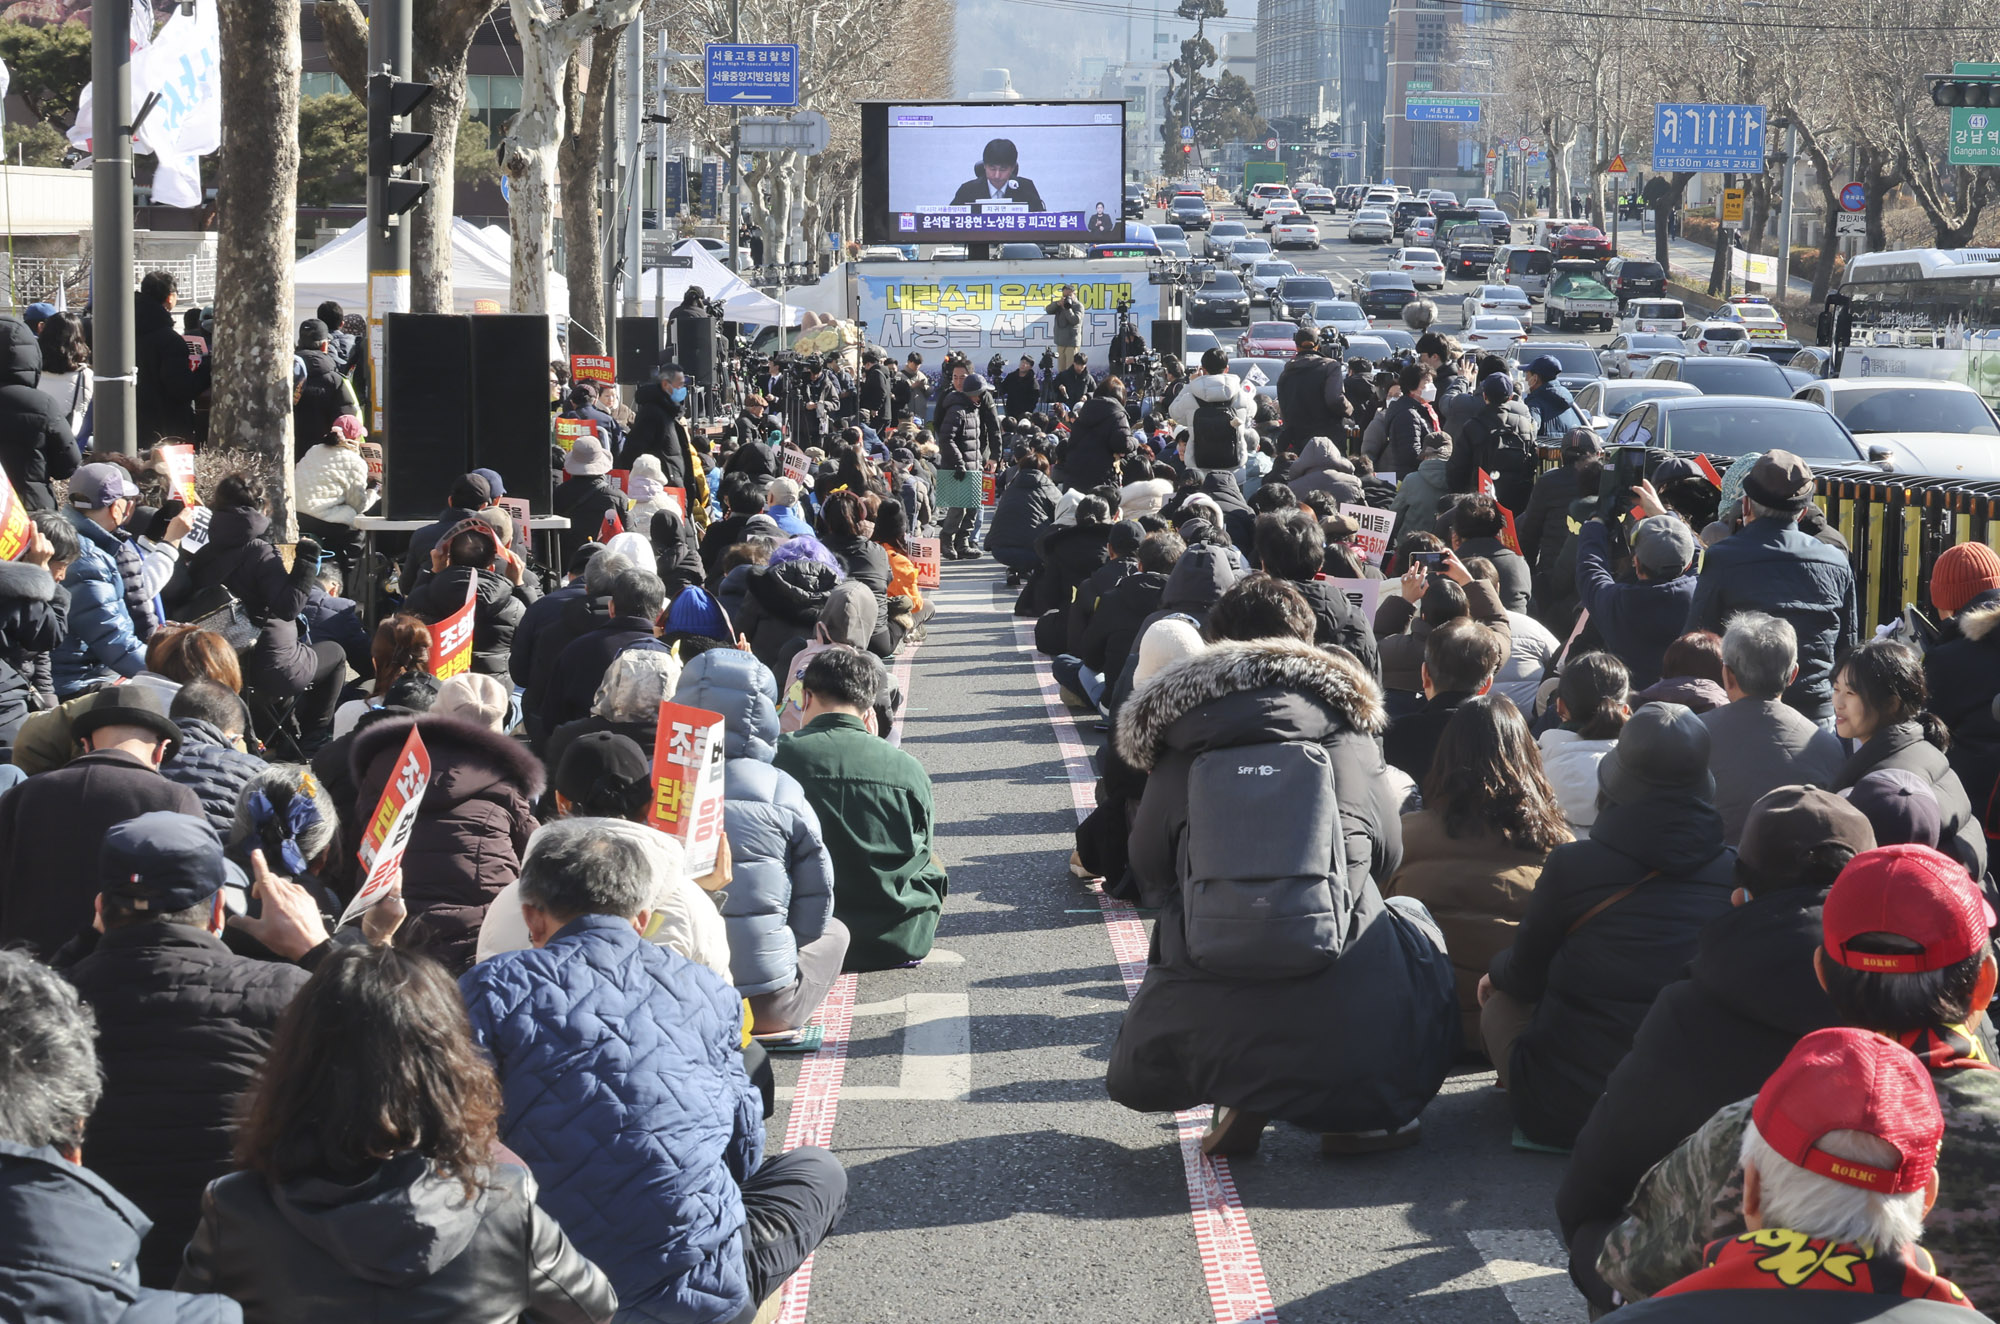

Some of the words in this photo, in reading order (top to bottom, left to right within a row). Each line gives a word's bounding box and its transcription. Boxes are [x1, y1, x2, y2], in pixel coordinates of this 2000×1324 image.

[712, 50, 790, 62] 서울고등검찰청
[712, 70, 790, 82] 서울중앙지방검찰청
[1955, 130, 1999, 145] 강남역
[1954, 146, 1988, 157] Gangnam
[1705, 159, 1729, 168] 서초역
[1733, 160, 1757, 169] 교차로
[922, 215, 1015, 229] 윤석열·김용현·노상원
[1017, 216, 1027, 229] 등
[1028, 215, 1057, 229] 피고인
[1059, 214, 1078, 228] 출석
[886, 283, 992, 311] 내란수괴
[879, 313, 982, 349] 사형을
[576, 358, 611, 369] 조희대를
[575, 369, 613, 381] 탄핵하라!
[557, 422, 591, 436] 조희대를
[1238, 765, 1254, 775] SFF
[1863, 957, 1898, 968] ROKMC
[1831, 1162, 1877, 1183] ROKMC
